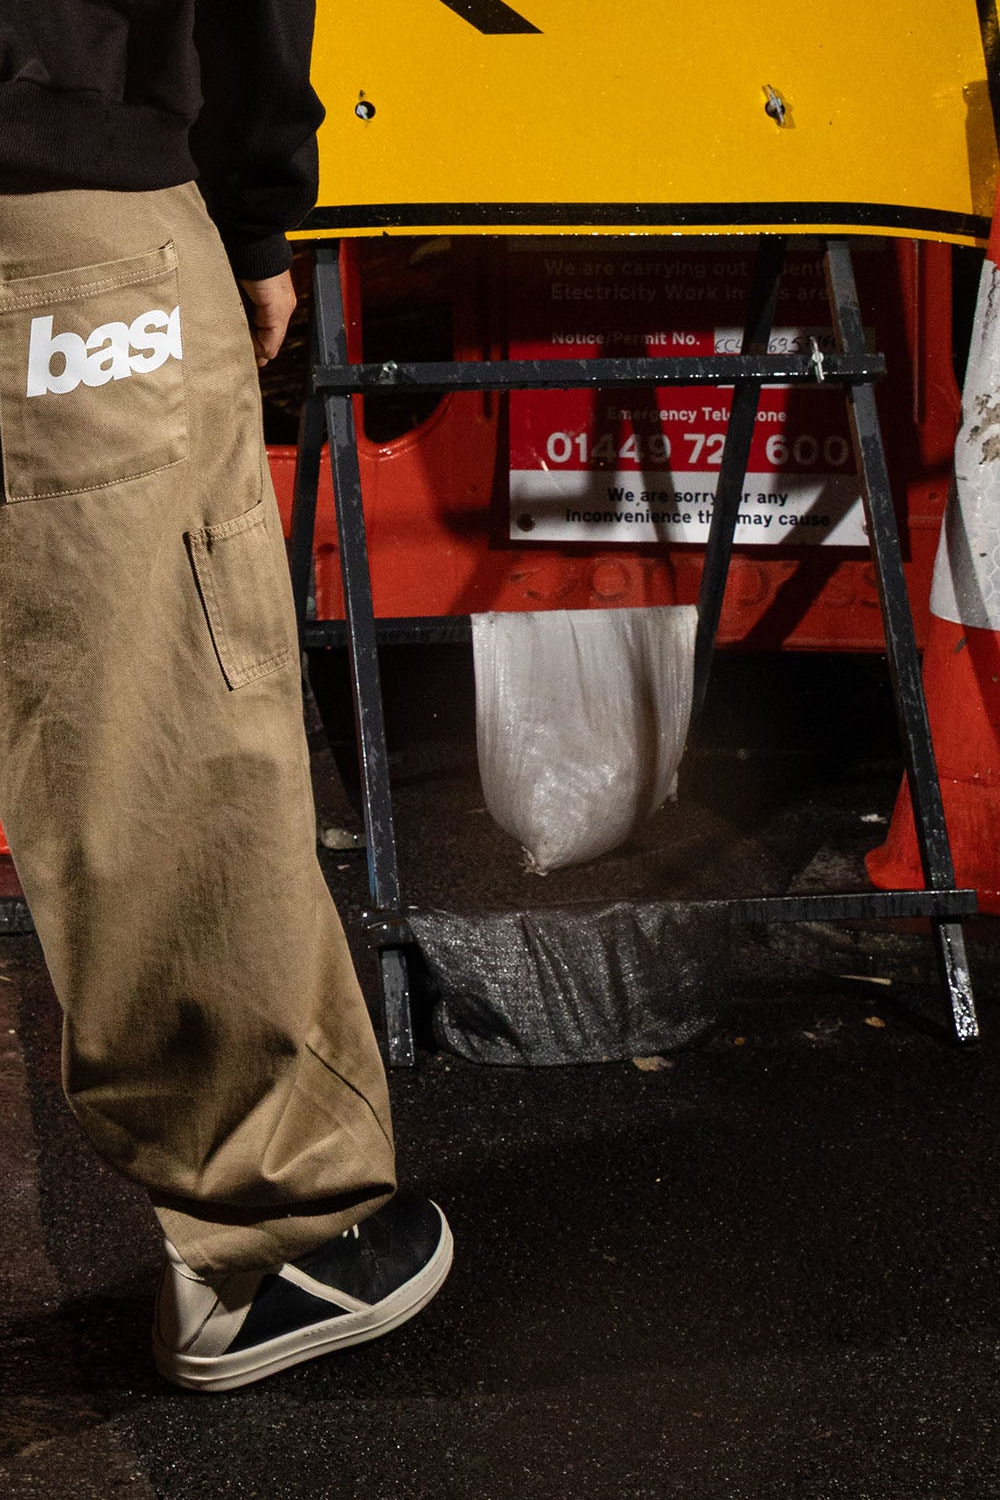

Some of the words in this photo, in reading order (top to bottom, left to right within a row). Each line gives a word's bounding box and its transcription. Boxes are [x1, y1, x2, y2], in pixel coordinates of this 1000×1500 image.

[543, 259, 575, 276] We
[583, 262, 615, 276] are
[621, 259, 707, 279] carrying
[712, 261, 748, 276] out
[551, 283, 656, 304] Electricity
[664, 283, 718, 301] Work
[551, 331, 667, 346] Notice/Permit
[672, 331, 701, 346] No.
[607, 407, 697, 424] Emergency
[546, 431, 672, 465] 01449
[683, 432, 727, 465] 72
[765, 433, 849, 467] 600
[608, 488, 634, 503] We
[640, 491, 668, 504] are
[674, 491, 718, 508] sorry
[757, 492, 789, 508] any
[566, 508, 692, 525] inconvenience
[736, 512, 771, 529] may
[778, 513, 831, 528] cause
